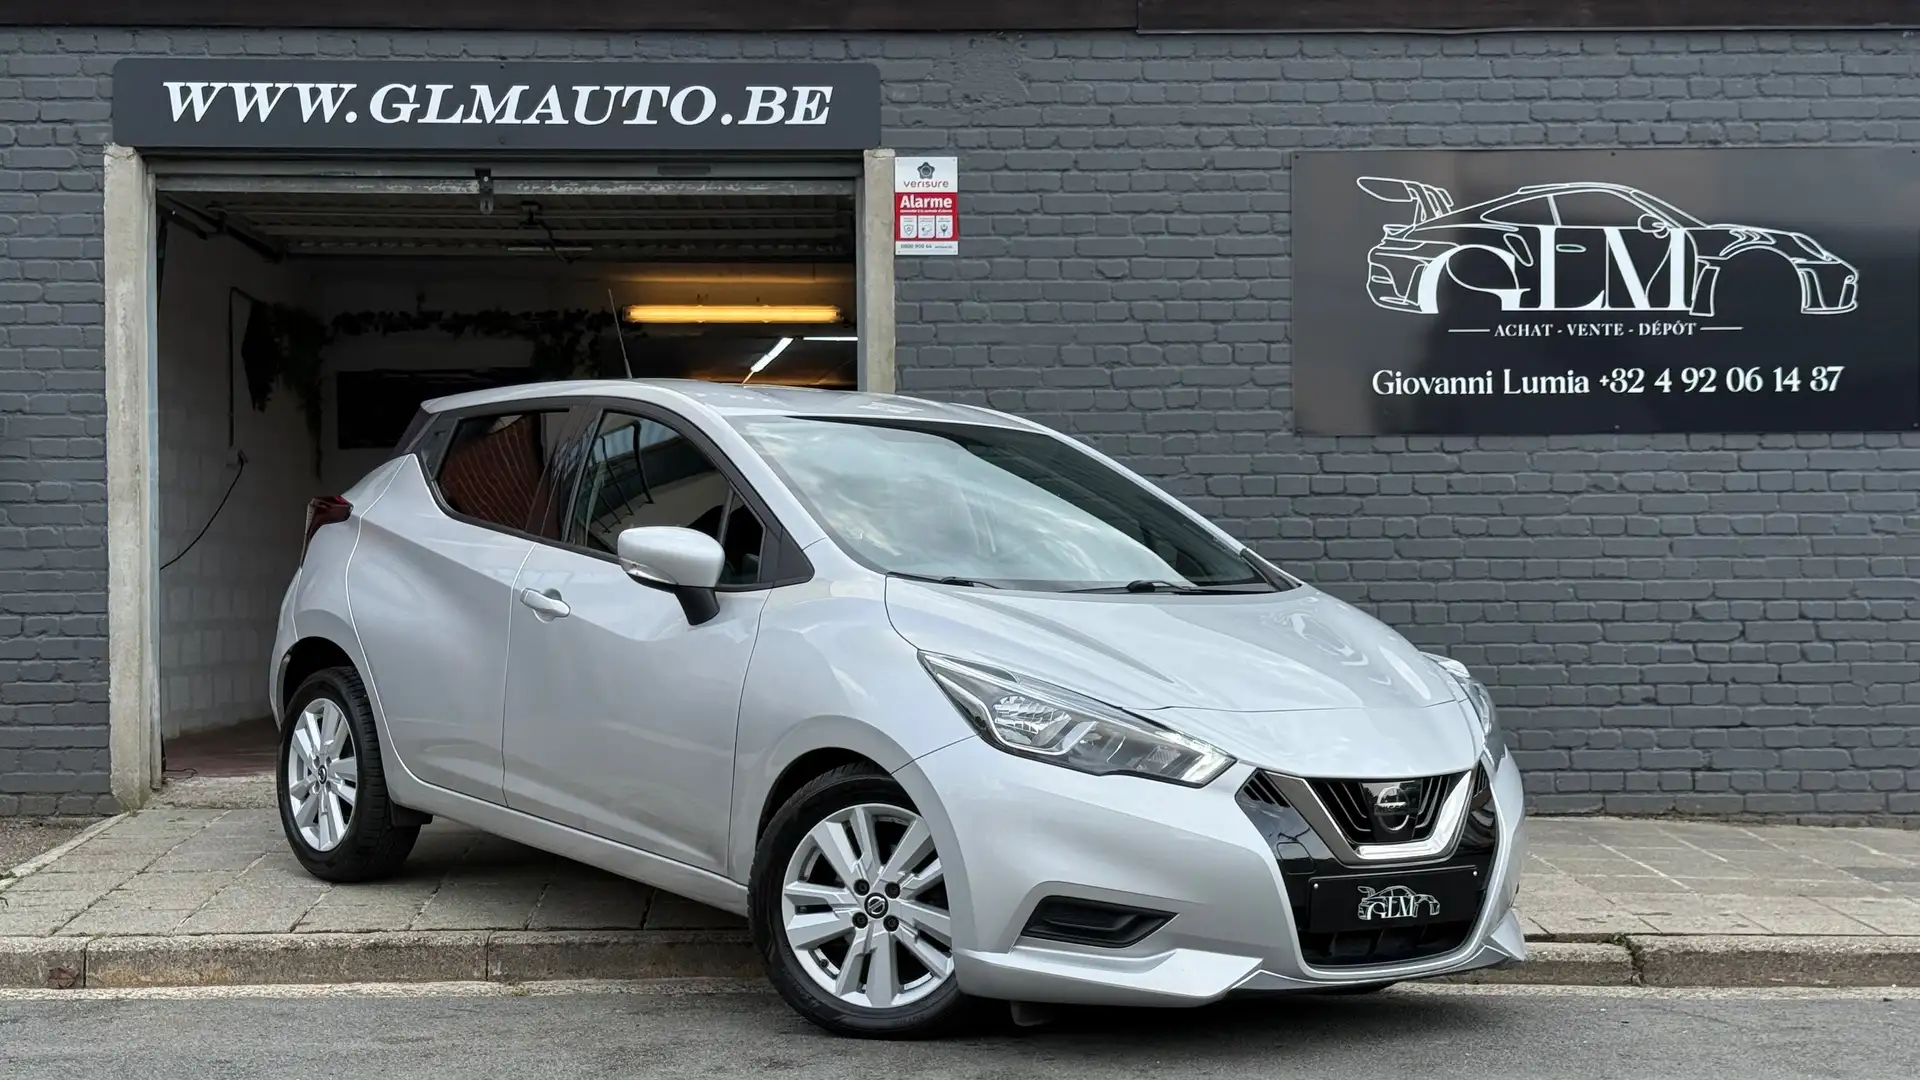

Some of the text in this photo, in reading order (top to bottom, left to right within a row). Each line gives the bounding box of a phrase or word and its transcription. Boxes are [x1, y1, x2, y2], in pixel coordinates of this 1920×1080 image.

[163, 82, 834, 126] WWW.GLMAUTO.BE
[903, 180, 949, 188] verisure
[900, 194, 953, 208] Alarme
[1418, 226, 1694, 314] GLM
[1494, 323, 1554, 337] ACHAT
[1566, 323, 1624, 337] VENTE
[1638, 320, 1697, 336] DÉPÔT
[1372, 365, 1845, 395] Giovanni Lumia +32 4 92 06 14 37
[1367, 895, 1414, 920] GLM
